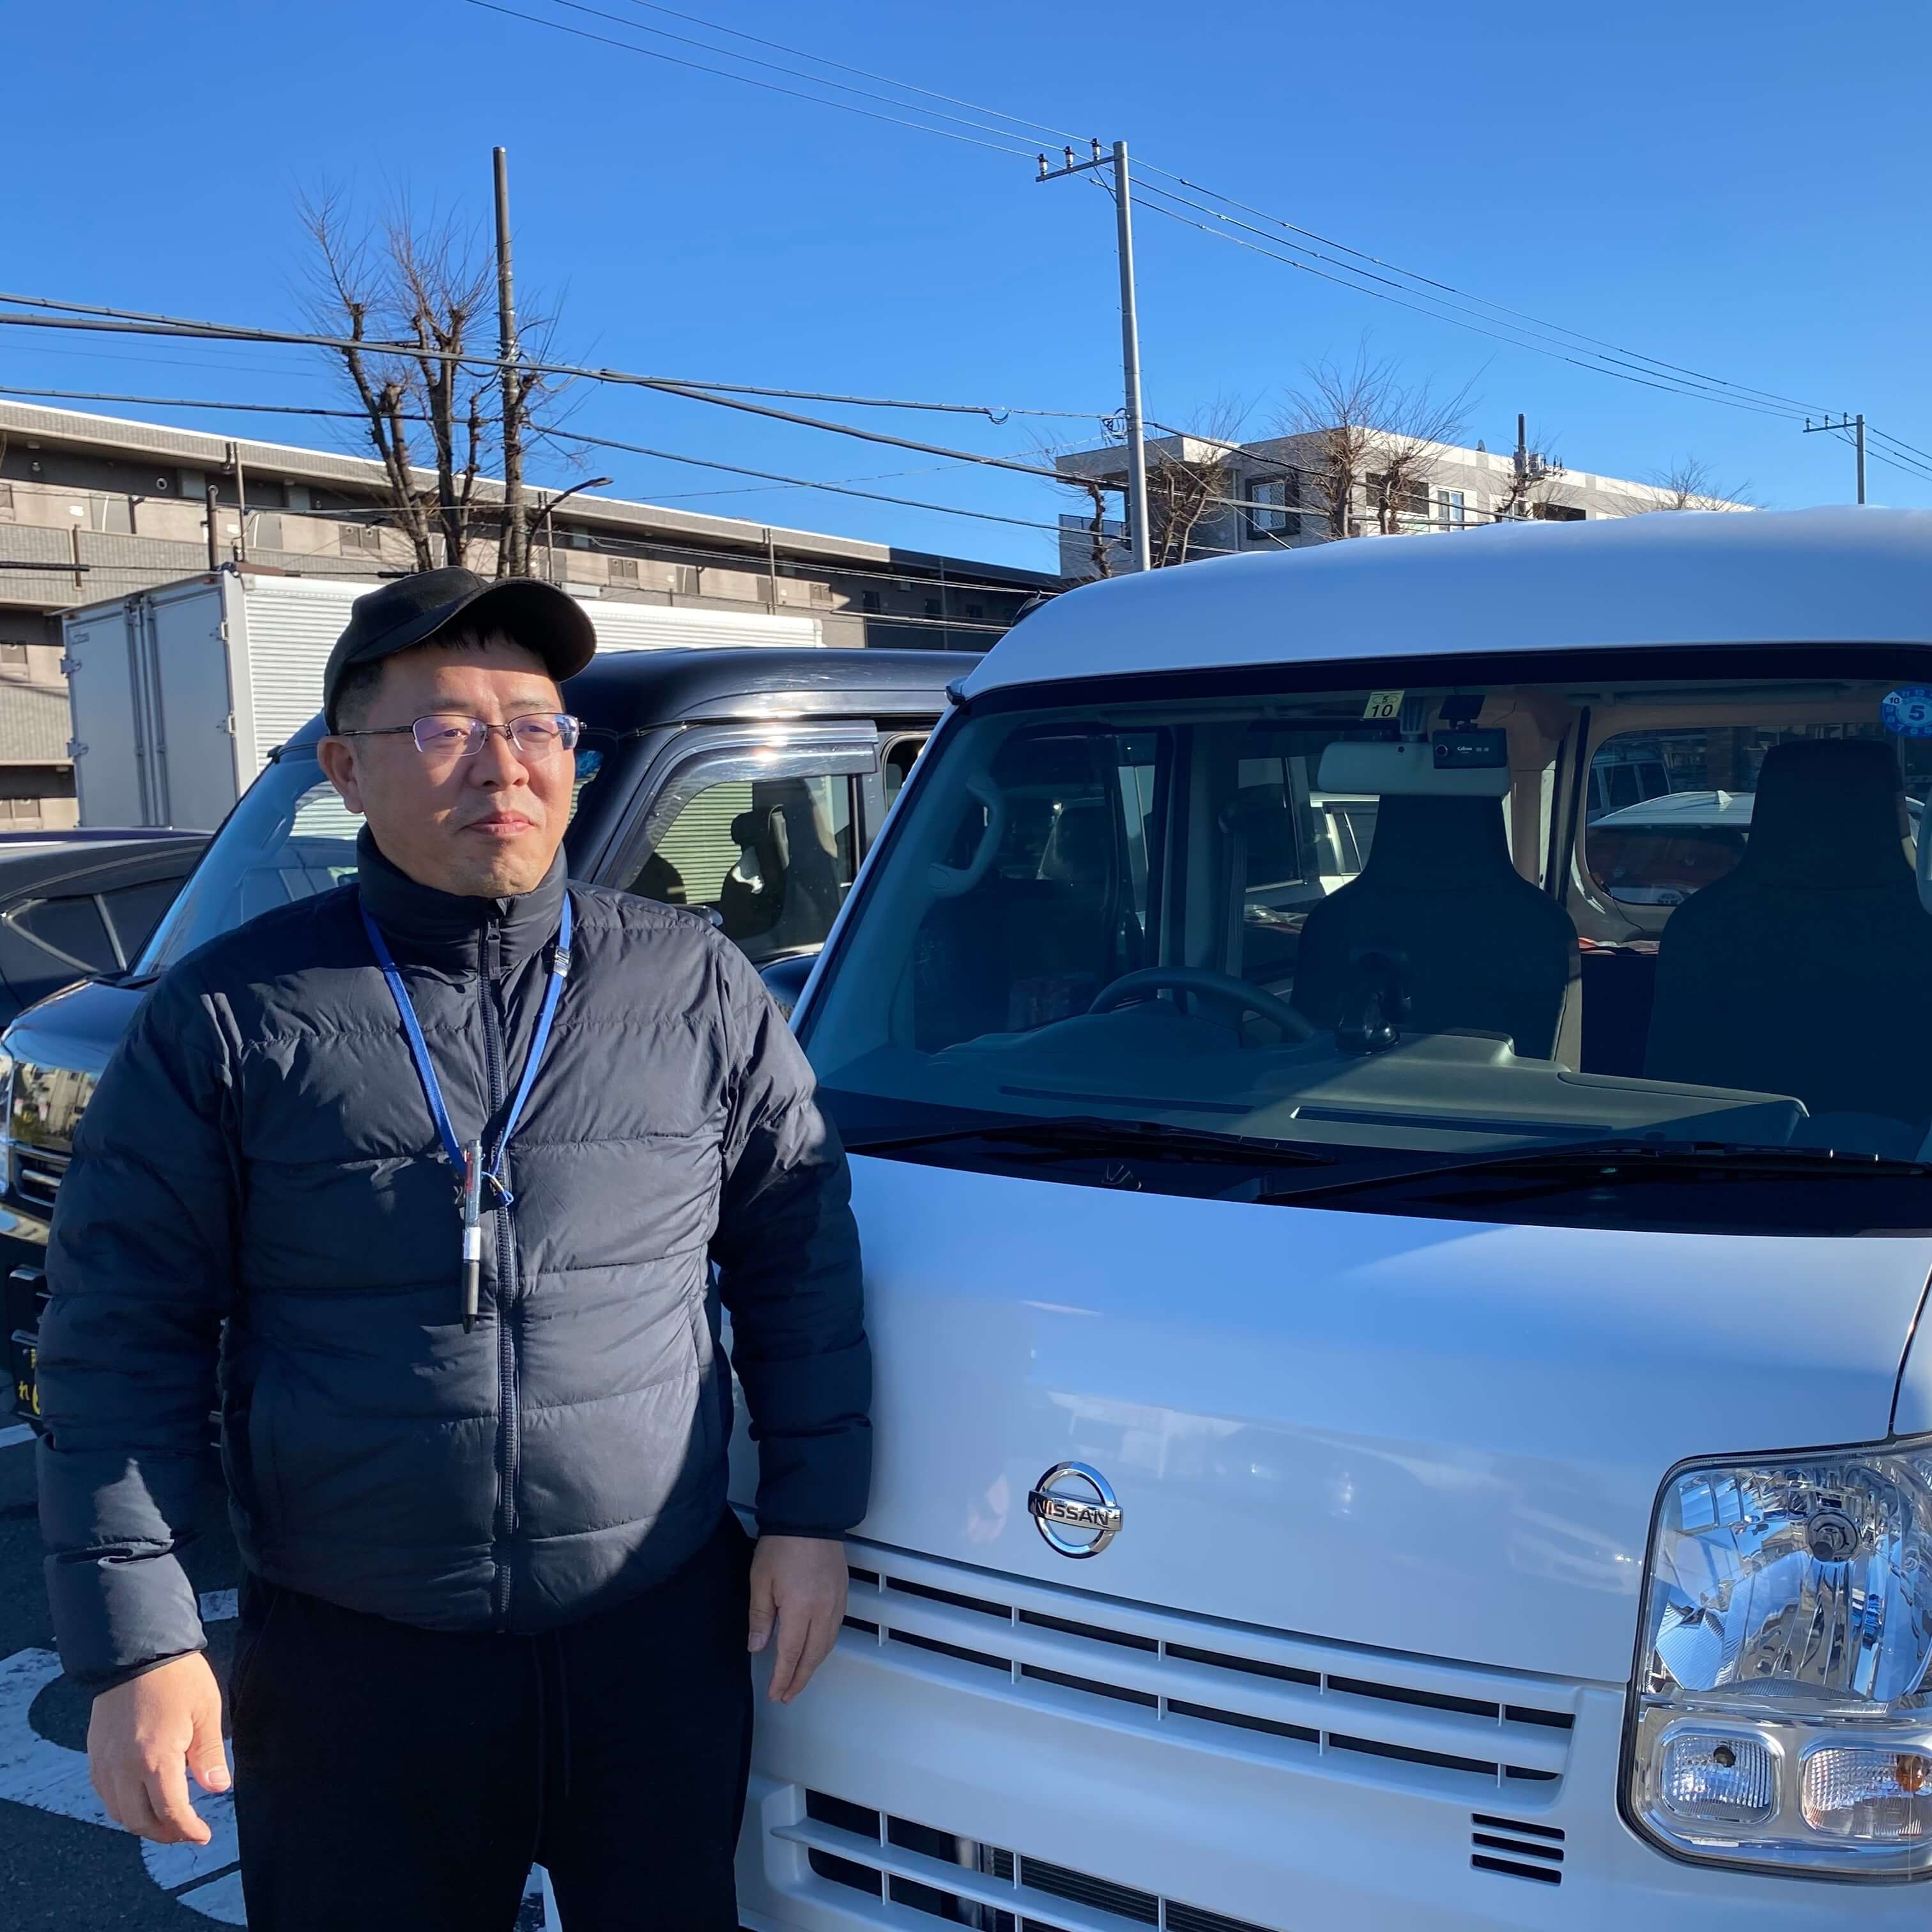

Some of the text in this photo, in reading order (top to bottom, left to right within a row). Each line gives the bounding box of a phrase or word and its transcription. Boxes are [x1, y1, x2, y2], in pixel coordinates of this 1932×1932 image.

[1372, 705, 1393, 717] 10
[1908, 705, 1925, 721] 5
[1034, 1498, 1108, 1526] NISSAN
